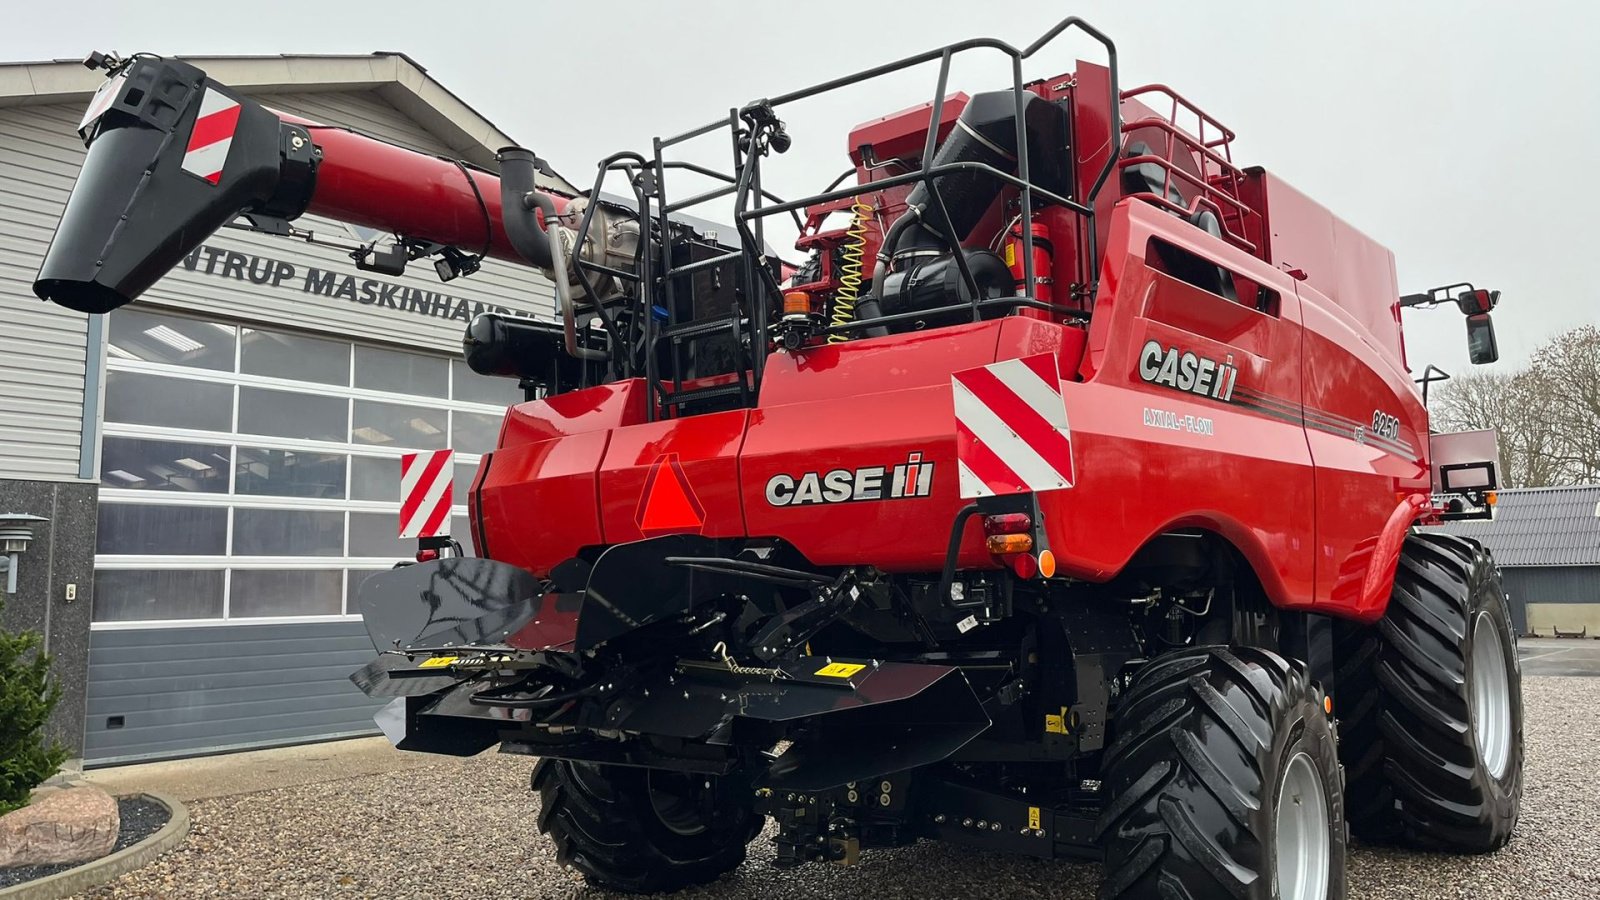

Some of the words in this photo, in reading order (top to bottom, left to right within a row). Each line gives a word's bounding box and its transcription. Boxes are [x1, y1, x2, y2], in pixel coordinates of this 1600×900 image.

[303, 267, 536, 323] MASKINHA
[1139, 340, 1215, 396] CASE
[1143, 407, 1214, 436] AXIAL-FLOW
[1371, 409, 1400, 441] 8250
[765, 468, 885, 506] CASE
